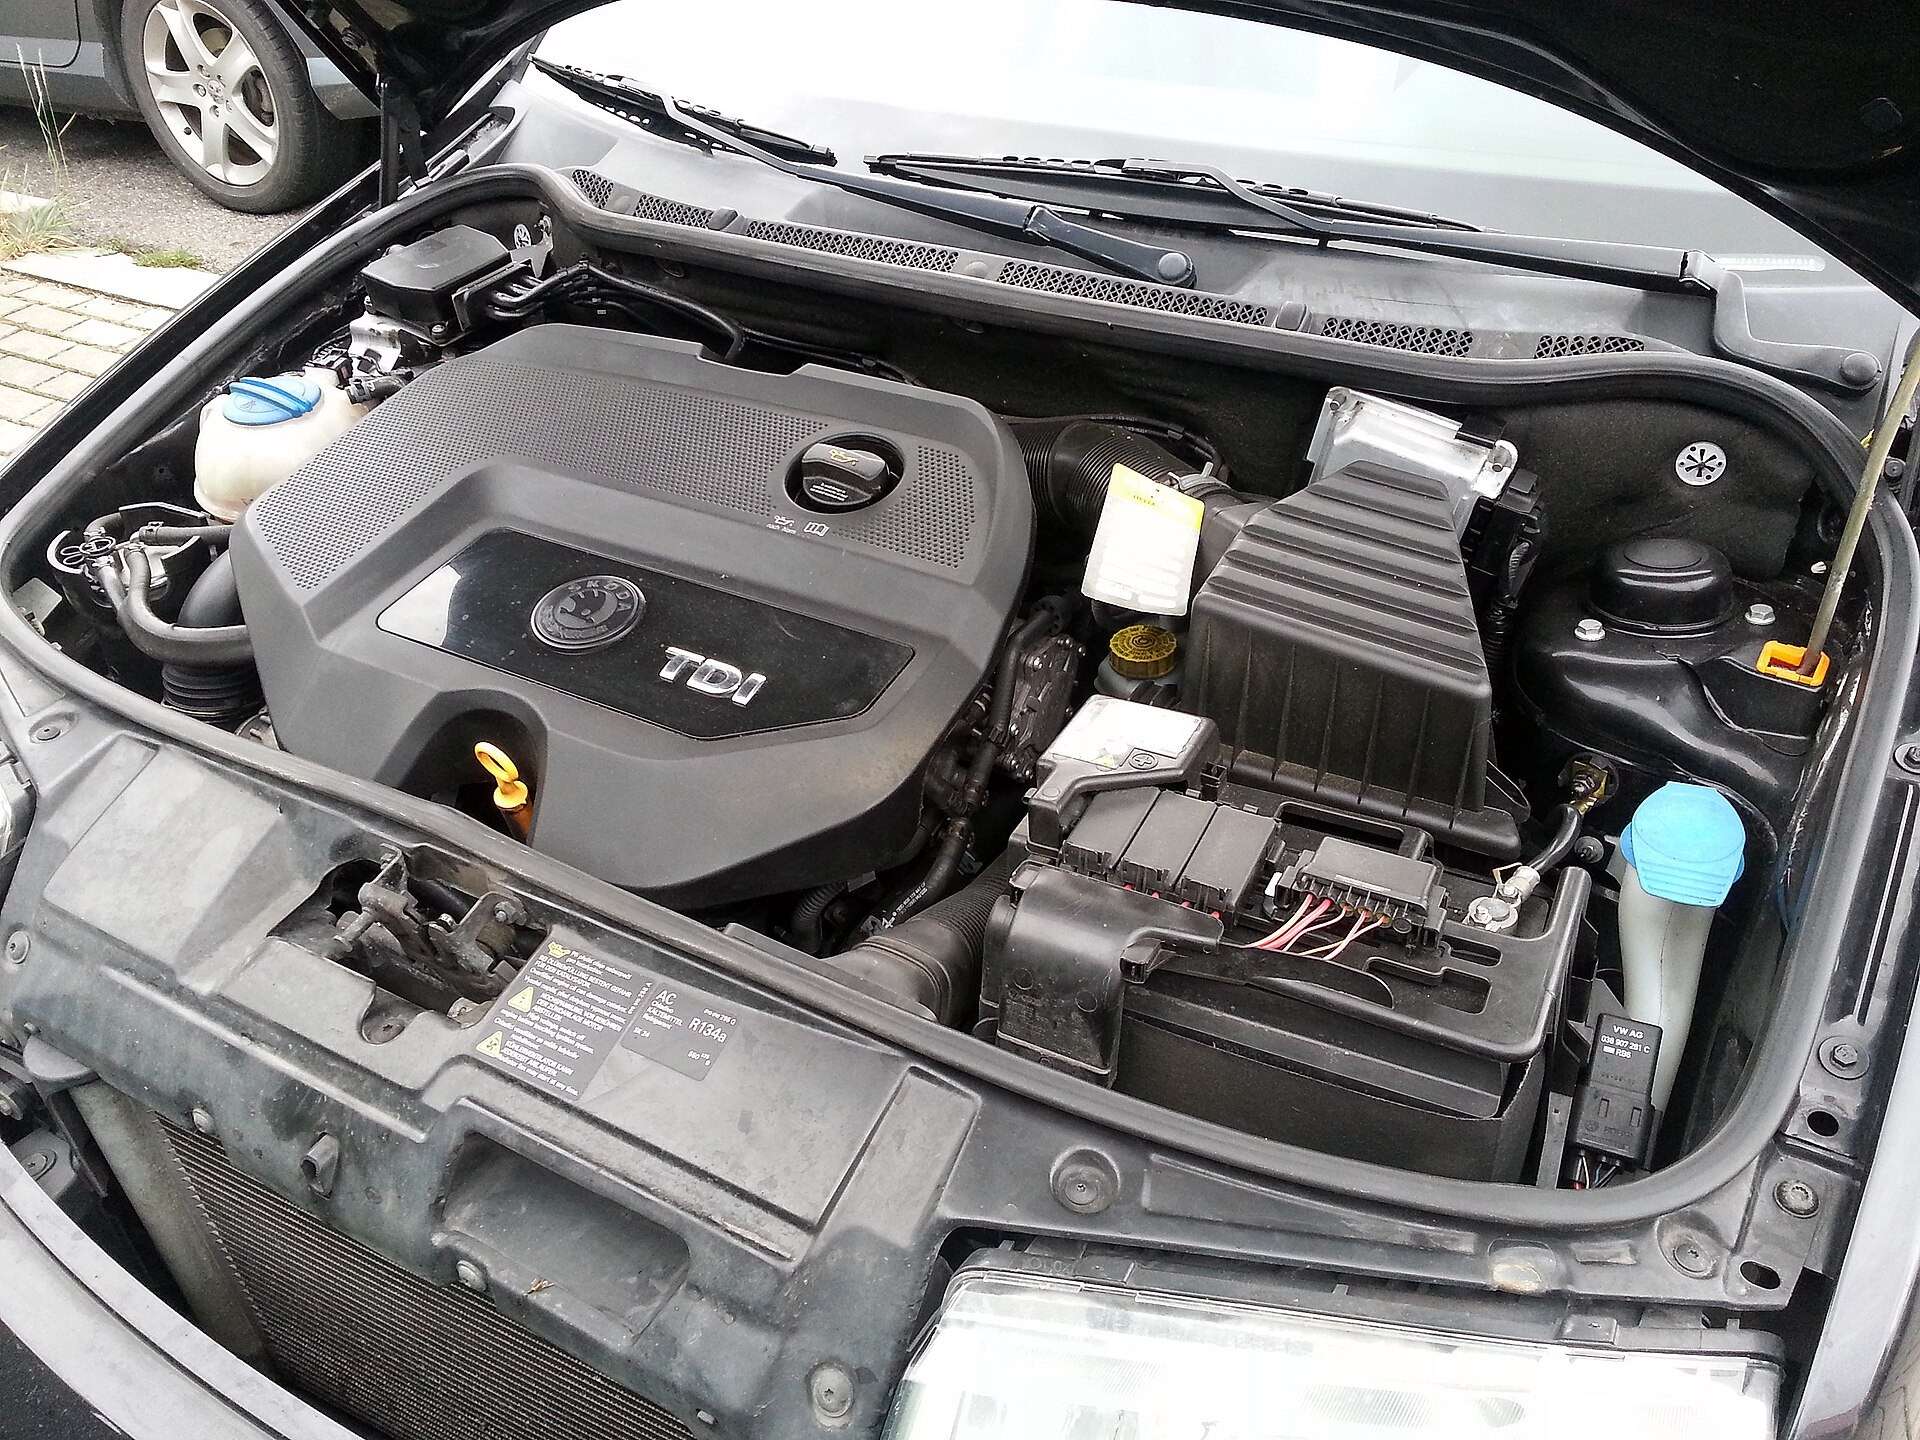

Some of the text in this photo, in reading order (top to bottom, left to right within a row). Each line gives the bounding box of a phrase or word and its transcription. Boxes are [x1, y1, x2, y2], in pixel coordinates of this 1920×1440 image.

[658, 646, 768, 708] TDI
[656, 991, 676, 1004] AC
[688, 1018, 727, 1043] R134a
[1613, 1025, 1644, 1039] VW AG
[1601, 1035, 1615, 1044] 038
[1615, 1039, 1629, 1047] 907
